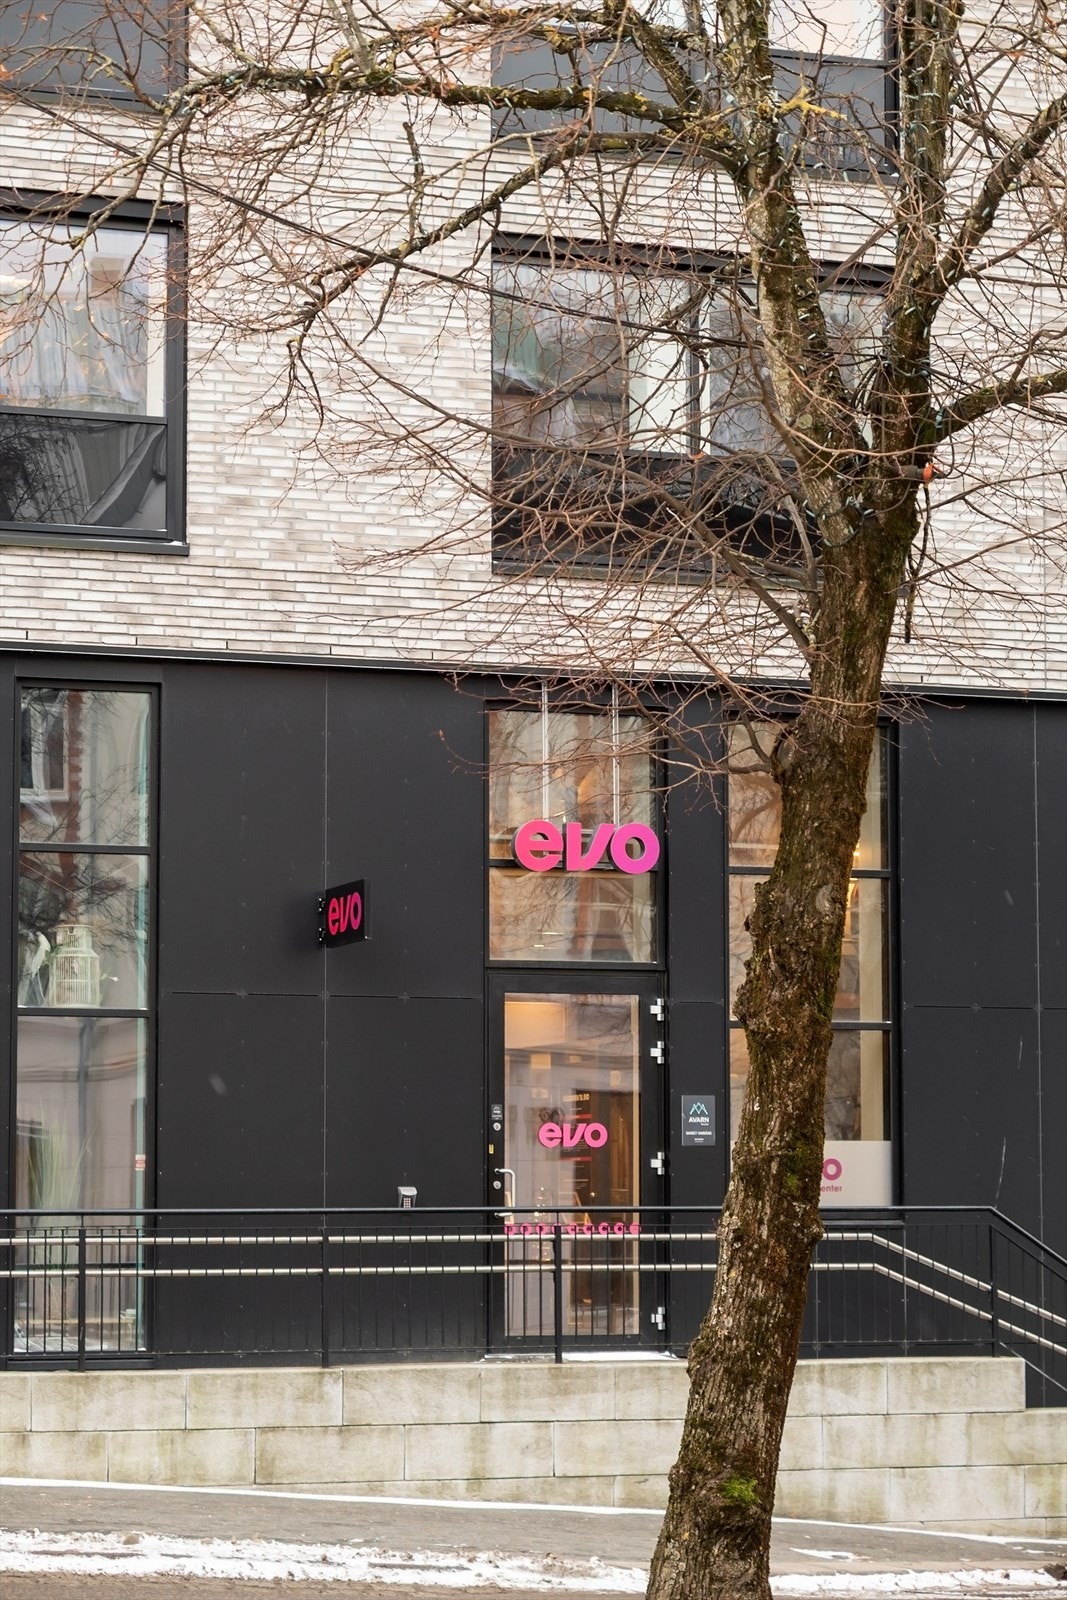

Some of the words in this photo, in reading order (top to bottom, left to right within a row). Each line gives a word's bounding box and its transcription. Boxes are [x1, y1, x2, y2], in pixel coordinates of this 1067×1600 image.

[513, 819, 660, 874] evo
[328, 891, 362, 936] evo
[538, 1122, 608, 1148] evo
